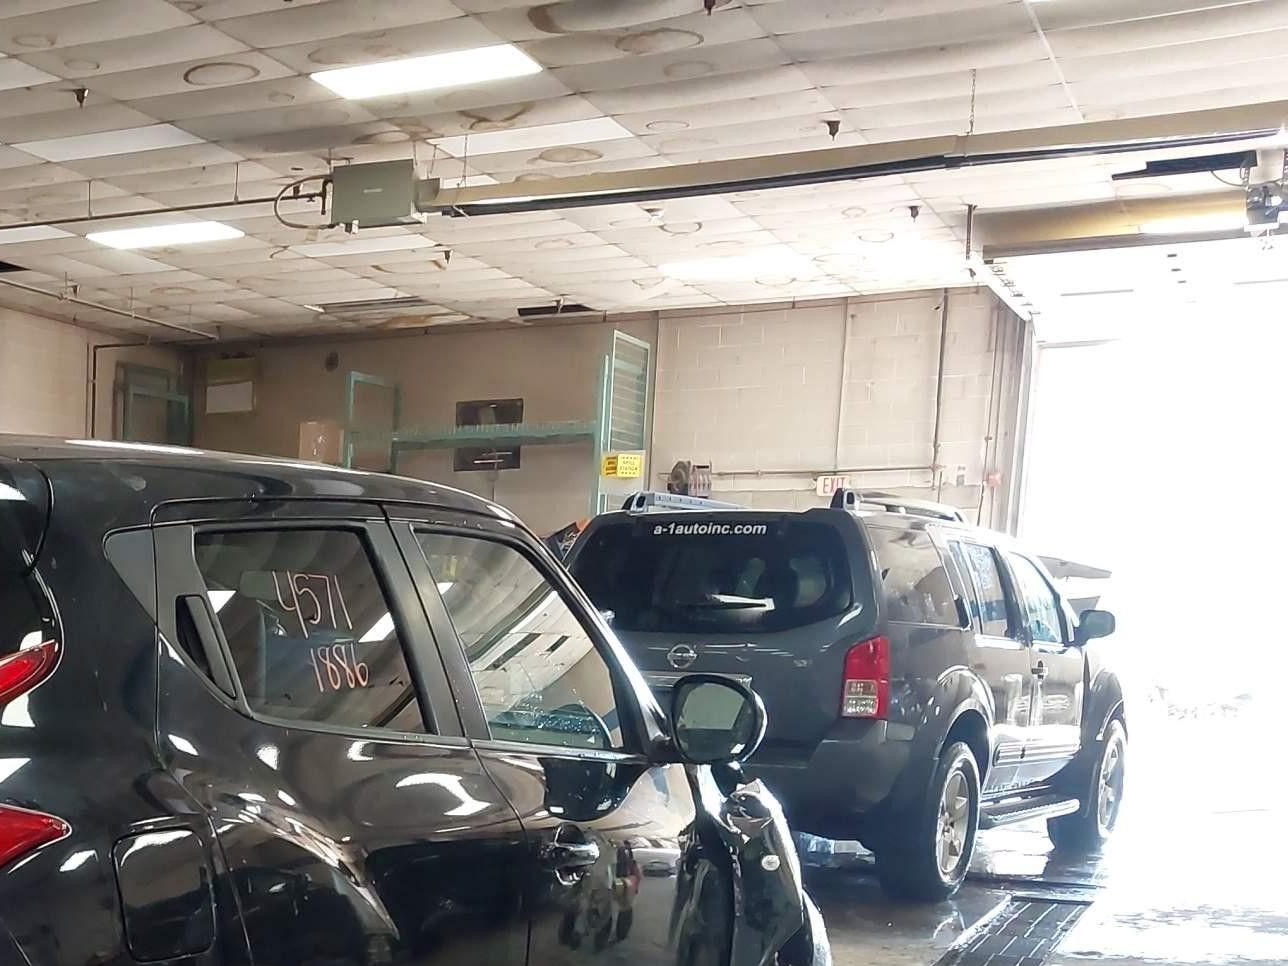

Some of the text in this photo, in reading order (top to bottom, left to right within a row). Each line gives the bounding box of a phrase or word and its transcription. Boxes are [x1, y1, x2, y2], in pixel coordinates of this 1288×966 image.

[823, 477, 846, 494] EXIT
[653, 522, 768, 535] a-1autoinc.com
[272, 570, 353, 639] 4571
[310, 643, 369, 693] 1886
